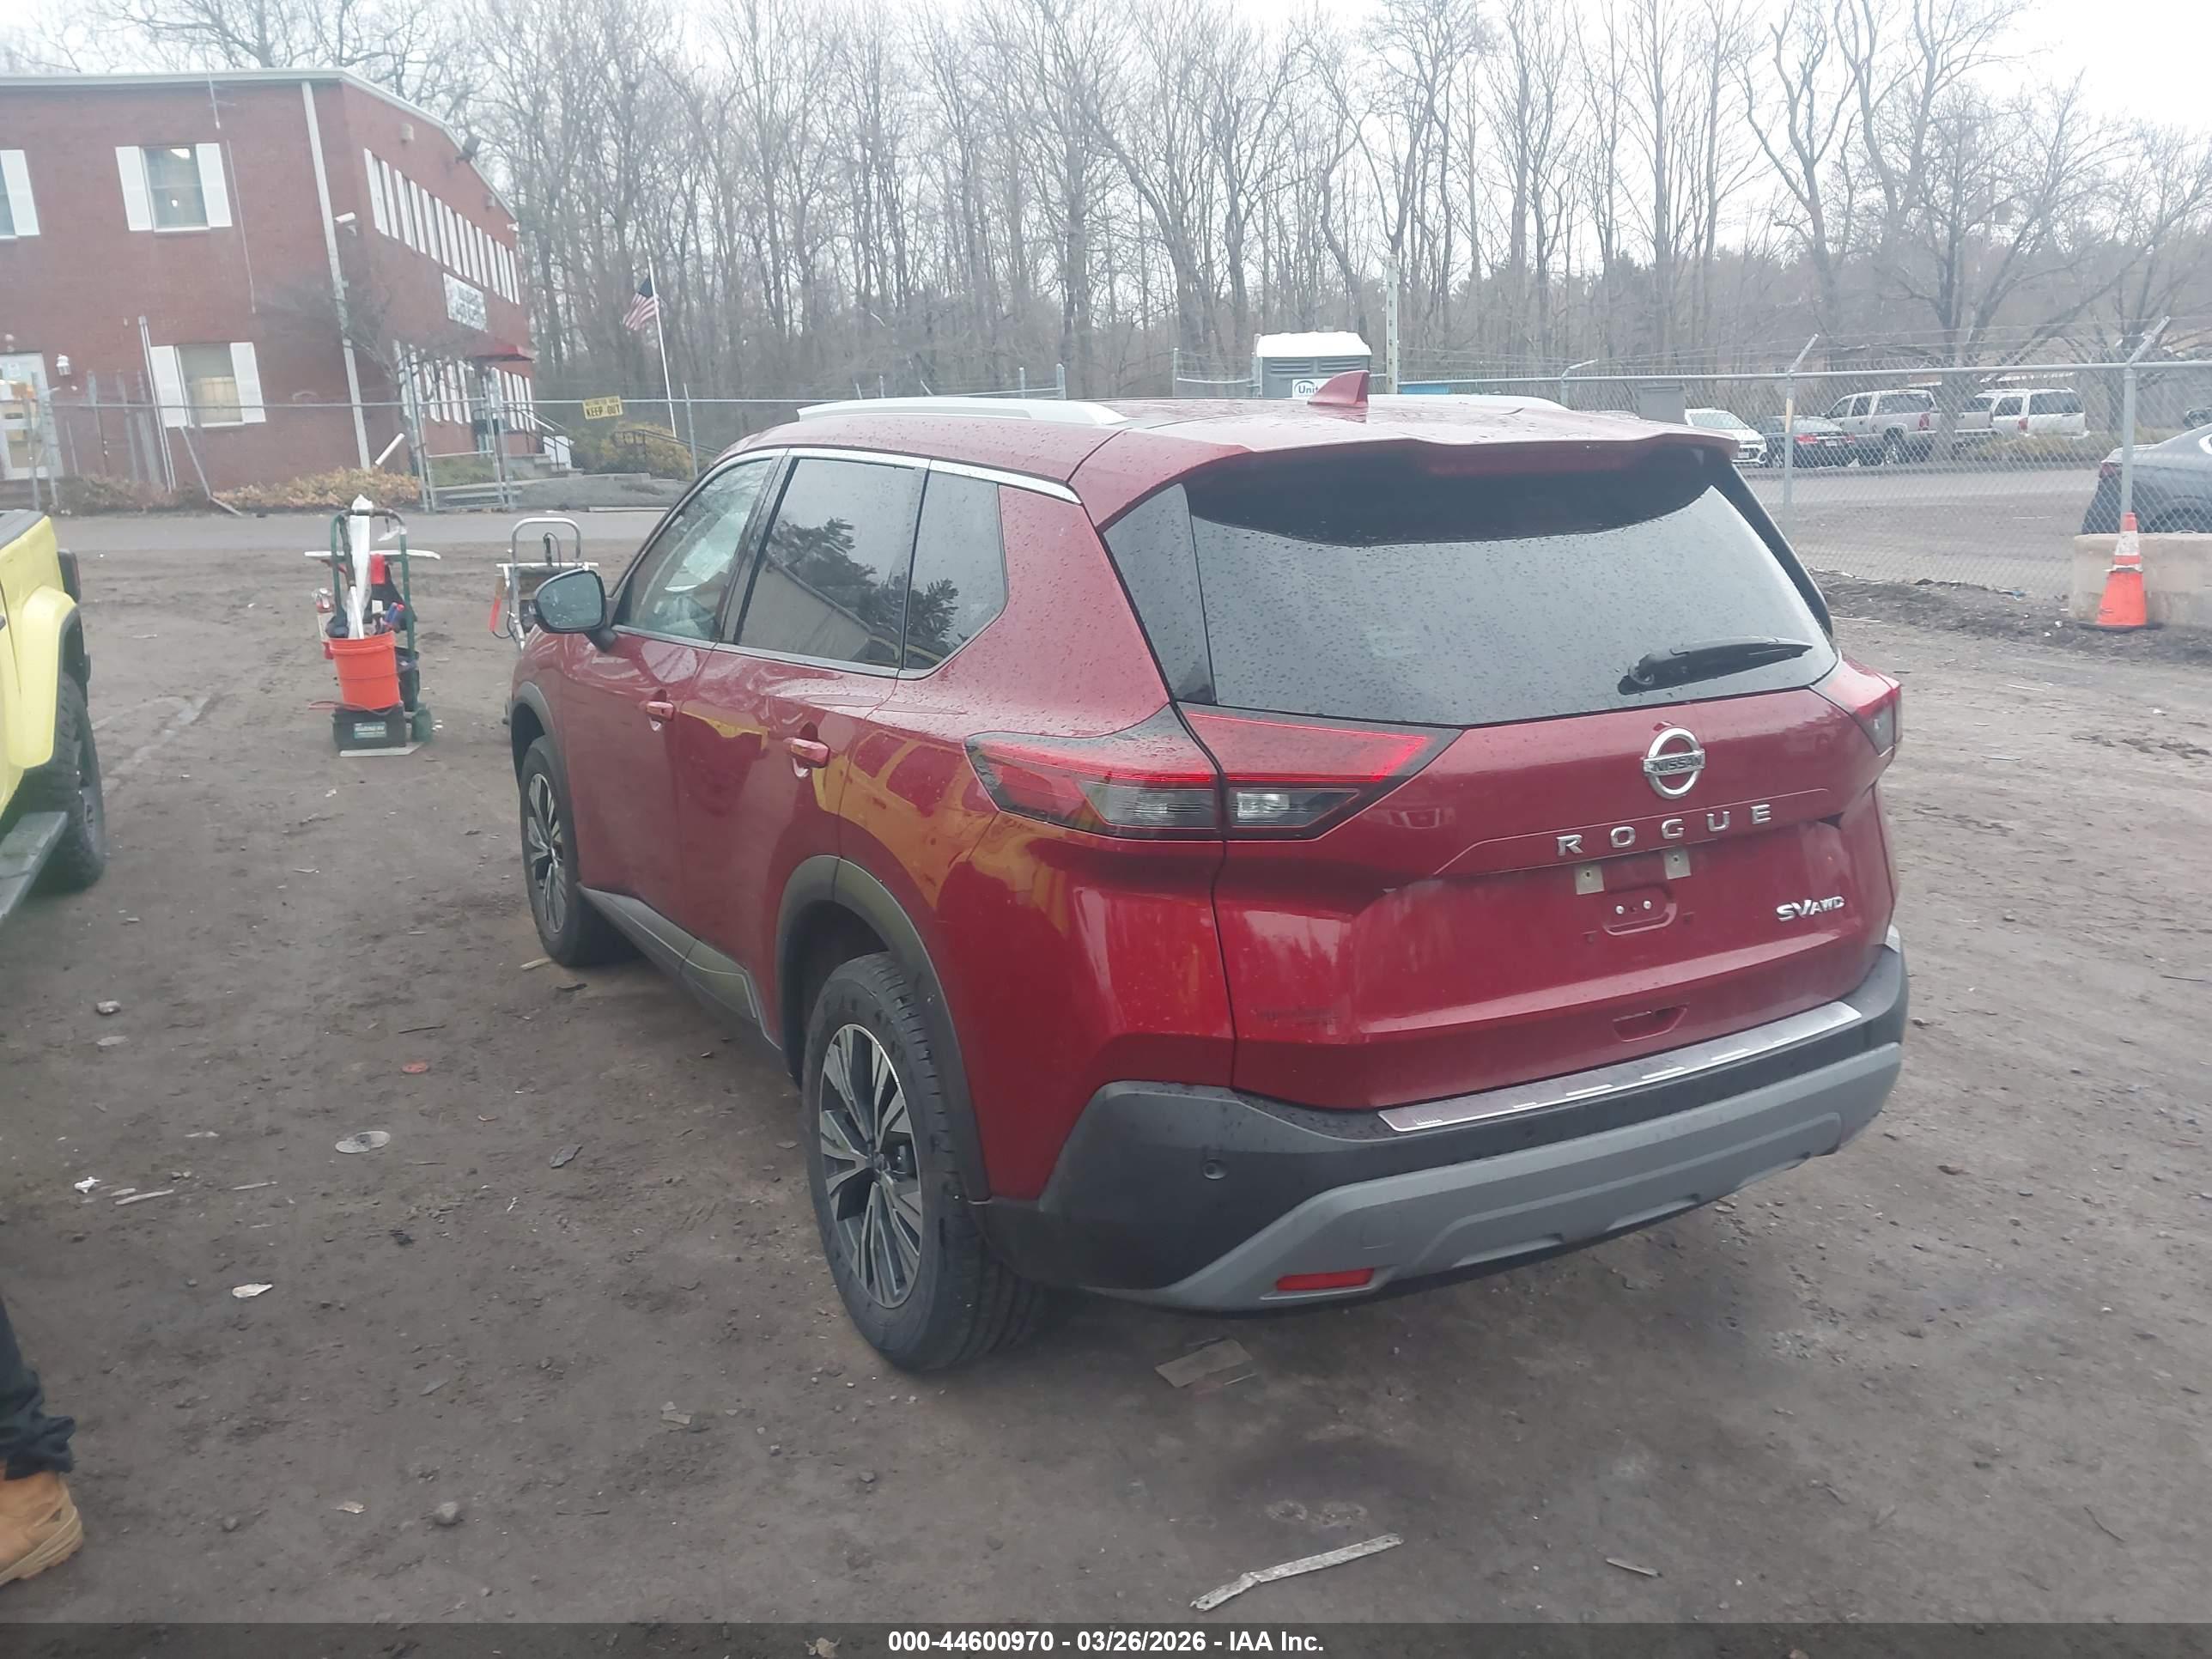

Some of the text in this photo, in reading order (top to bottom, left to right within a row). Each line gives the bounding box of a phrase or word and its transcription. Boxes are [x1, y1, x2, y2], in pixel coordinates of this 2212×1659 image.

[586, 404, 620, 416] KEEP OUT
[1650, 756, 1701, 772] NISSAN
[1556, 803, 1772, 857] ROGUE
